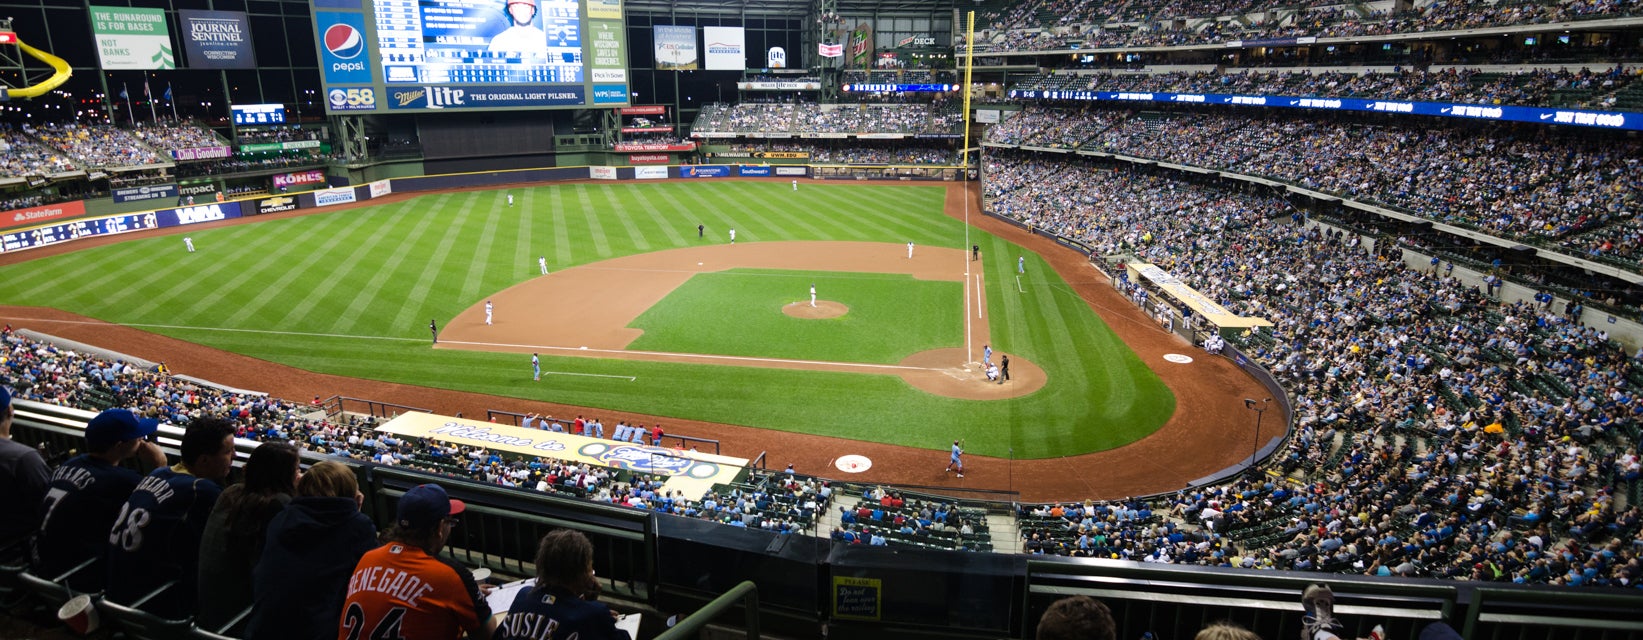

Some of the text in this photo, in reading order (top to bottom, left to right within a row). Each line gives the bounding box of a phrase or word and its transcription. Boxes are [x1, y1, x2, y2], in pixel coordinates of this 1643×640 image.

[95, 12, 162, 22] THE RUNAROUND
[128, 23, 154, 32] BASES
[191, 23, 242, 33] JOURNAL
[192, 32, 244, 42] SENTINEL
[103, 48, 130, 56] BANKS
[771, 51, 784, 60] Lite
[333, 62, 363, 72] pepsi
[347, 88, 374, 105] 58
[394, 86, 465, 109] Miller Lite
[178, 147, 227, 160] Club Goodwill
[179, 184, 215, 195] impact
[261, 204, 295, 213] CHEVROLET
[429, 422, 566, 451] Welcome to
[42, 487, 68, 530] 7
[108, 501, 150, 551] 28
[347, 566, 434, 607] RENEGADE
[343, 602, 407, 640] 24
[502, 612, 559, 640] SUSIE
